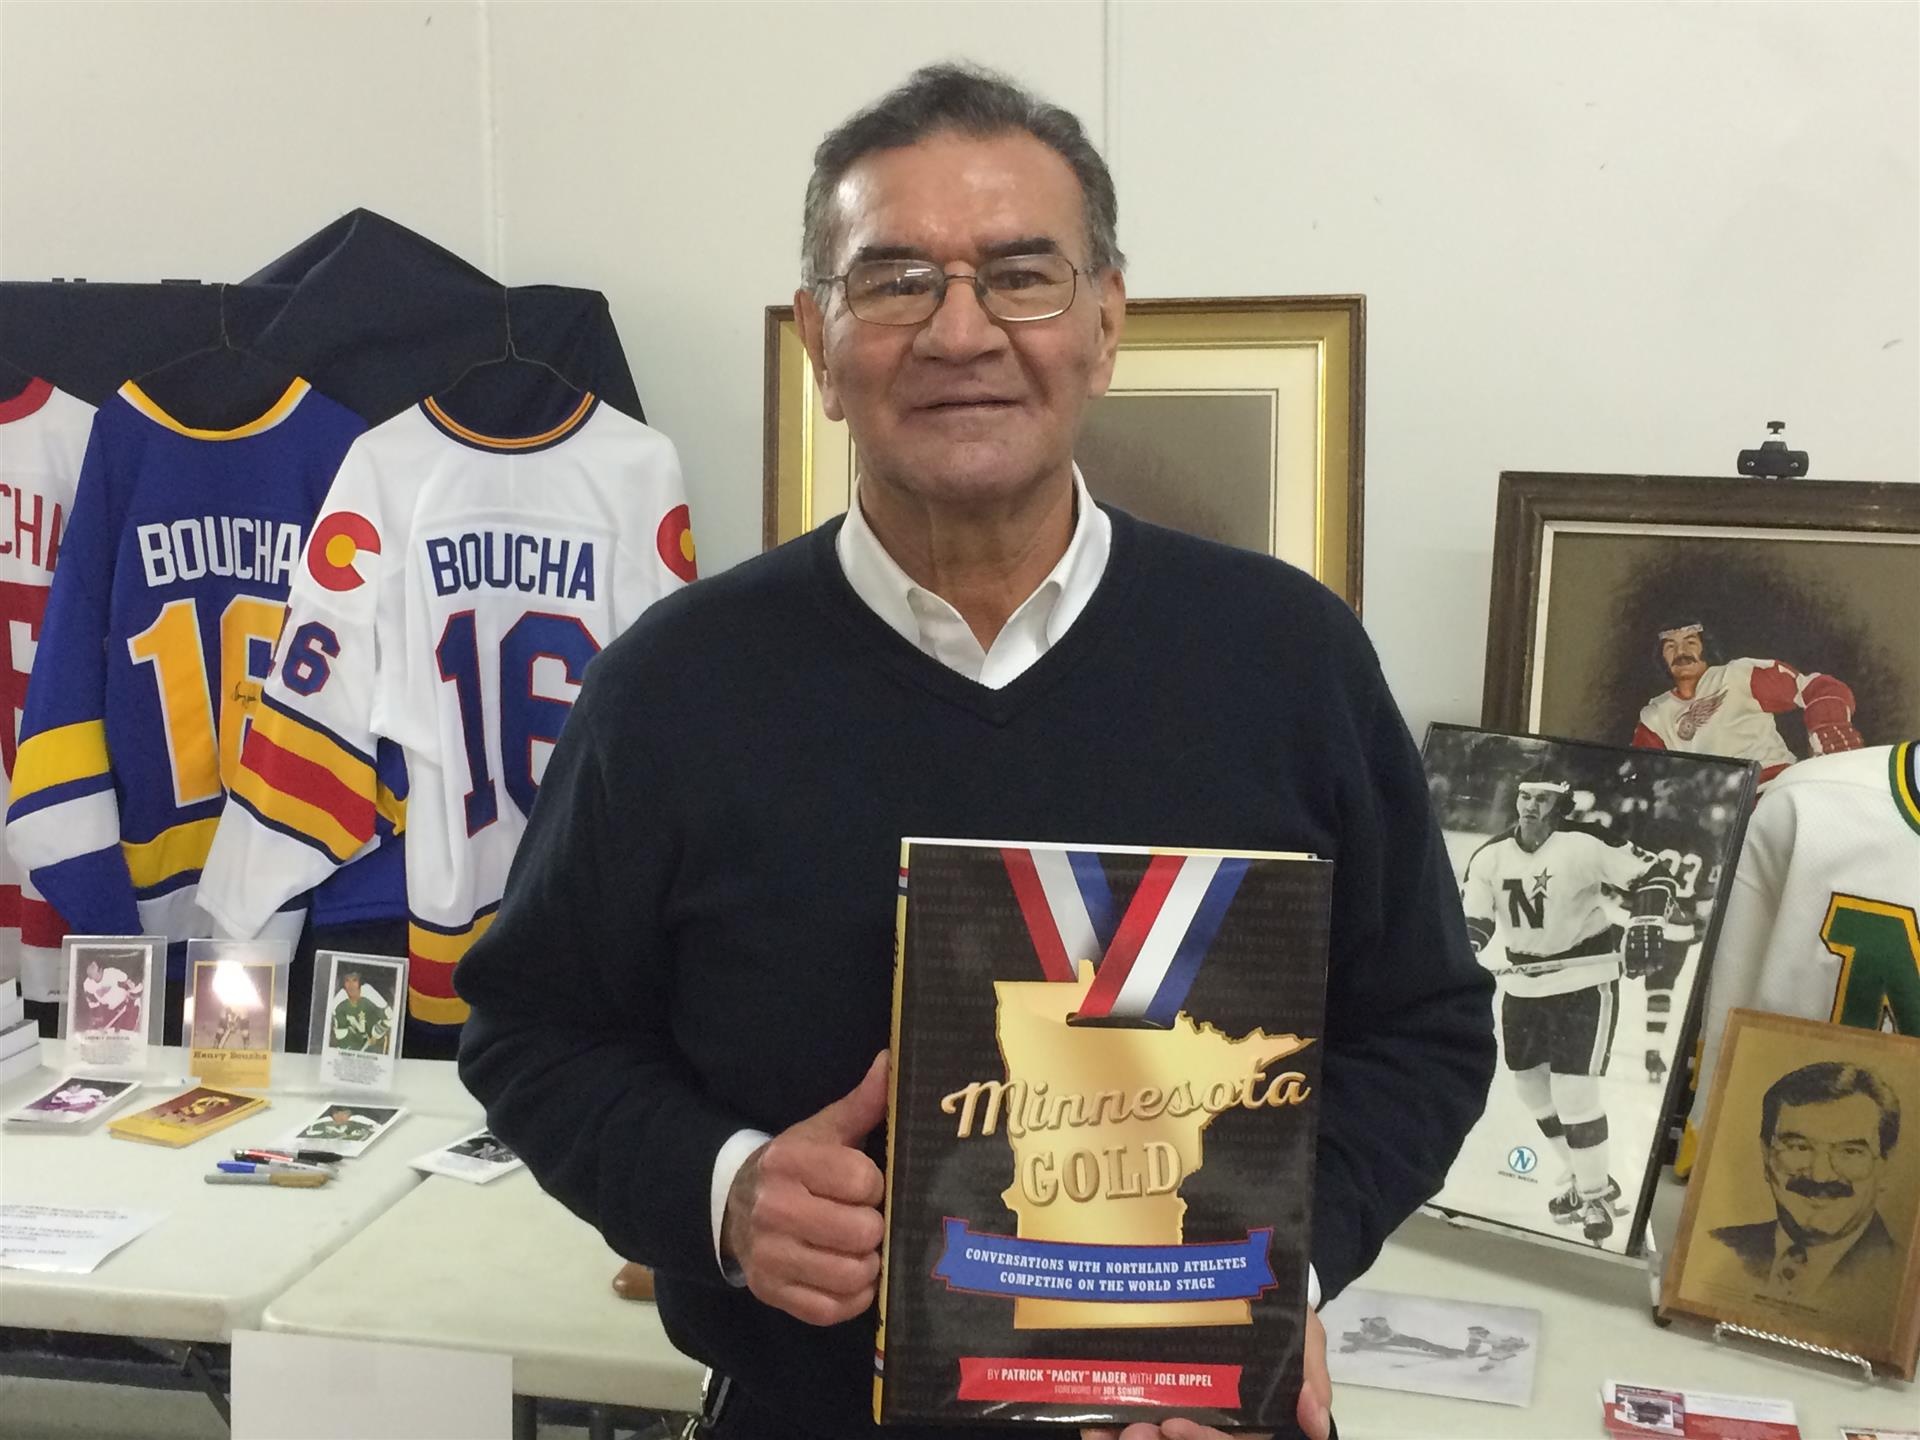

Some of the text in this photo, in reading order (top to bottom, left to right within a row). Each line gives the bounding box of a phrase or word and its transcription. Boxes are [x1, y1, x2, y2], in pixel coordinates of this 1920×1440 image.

[137, 516, 301, 587] BOUCHA
[426, 531, 595, 602] BOUCHA
[435, 608, 602, 839] 16
[941, 1058, 1312, 1138] Minnesota
[1021, 1140, 1183, 1207] GOLD
[965, 1247, 1247, 1274] CONVERSATIONS WITH NORTHLAND ATHLETES
[1000, 1271, 1216, 1292] COMPETING ON THE WORLD STAGE
[986, 1368, 1000, 1381] BY
[1001, 1368, 1044, 1382] PATRICK
[1092, 1371, 1127, 1384] MADER
[1129, 1371, 1152, 1385] WITH
[1154, 1373, 1177, 1386] JOEL
[1179, 1374, 1213, 1387] RIPPEL
